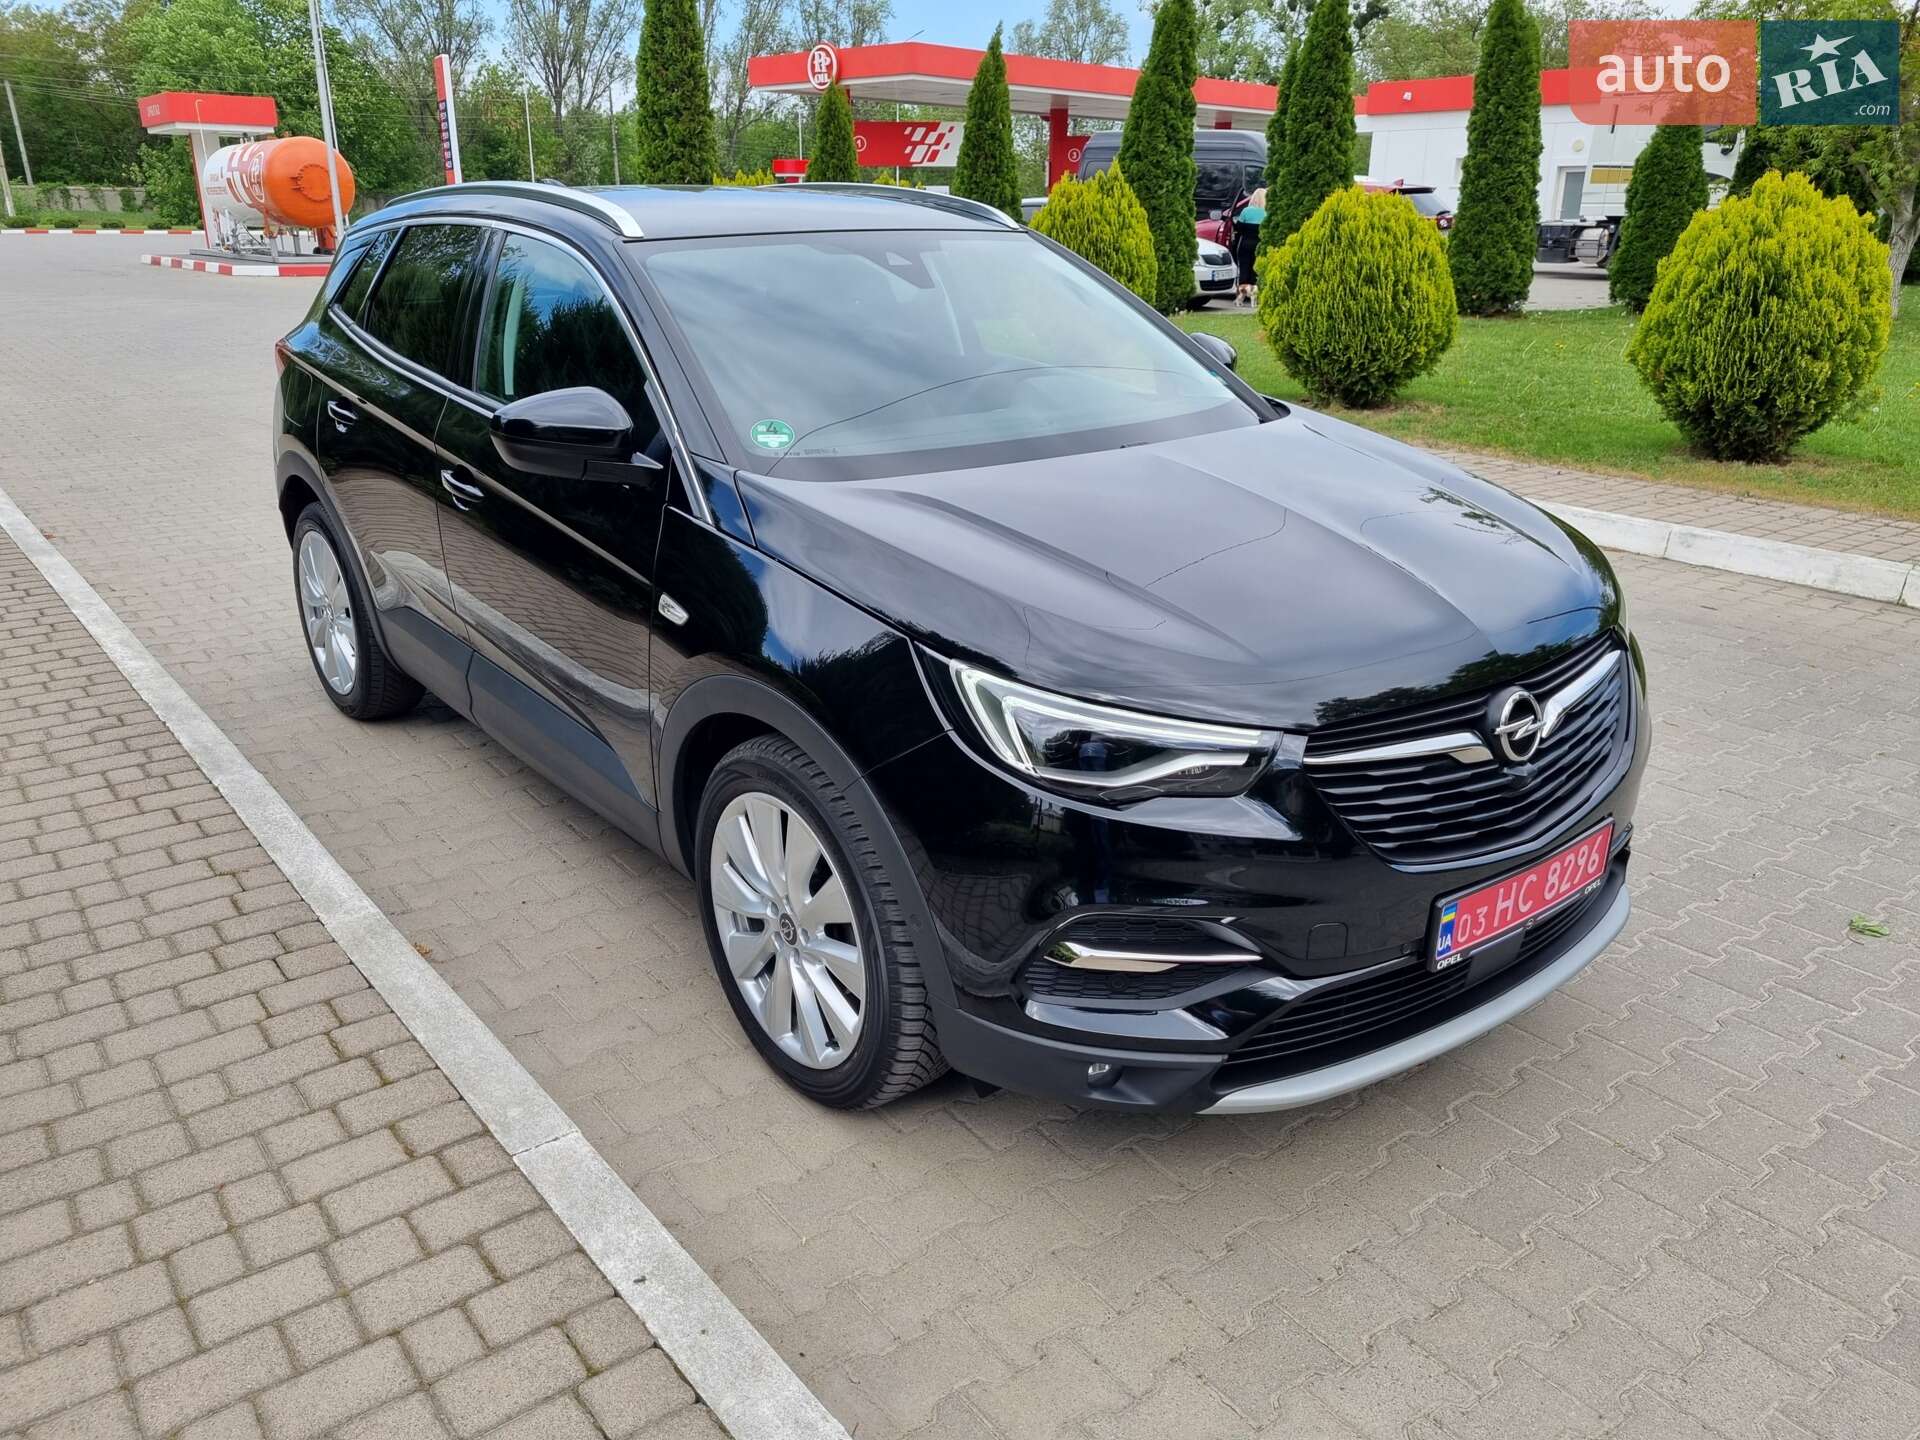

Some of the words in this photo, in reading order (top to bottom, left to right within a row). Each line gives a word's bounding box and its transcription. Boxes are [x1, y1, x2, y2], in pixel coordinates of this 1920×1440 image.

[1457, 905, 1489, 943] 03
[1544, 834, 1603, 900] 8296
[1437, 933, 1452, 952] UA
[1436, 952, 1464, 970] OPEL
